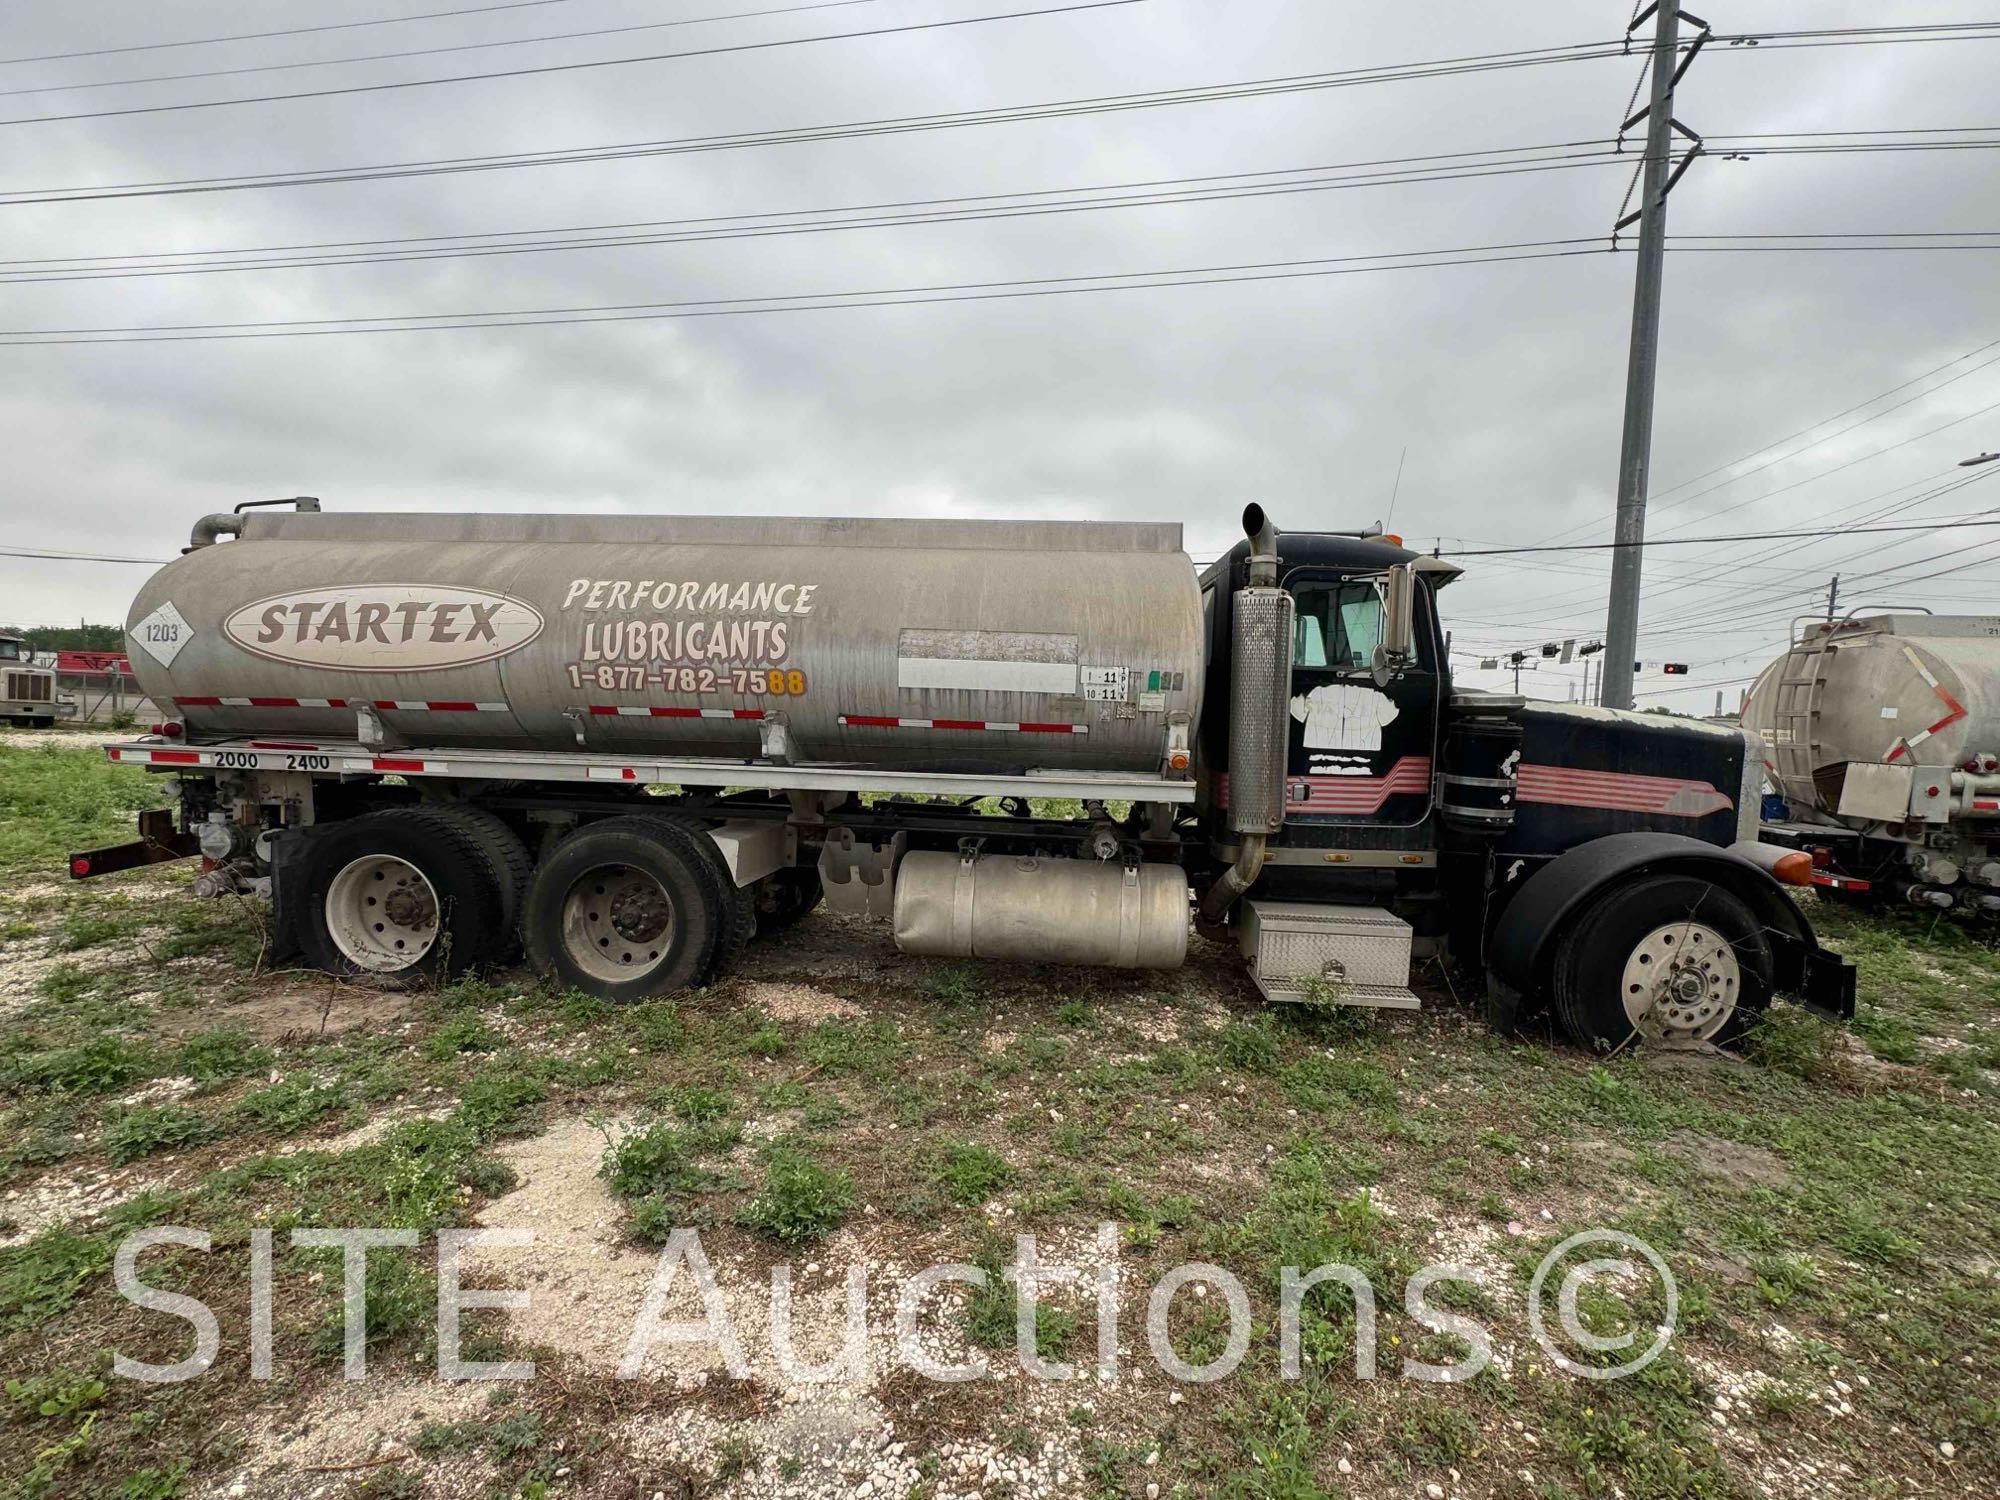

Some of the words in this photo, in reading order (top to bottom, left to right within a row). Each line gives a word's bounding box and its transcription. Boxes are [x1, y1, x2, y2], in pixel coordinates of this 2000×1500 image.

[562, 578, 818, 614] PERFORMANCE
[146, 624, 178, 642] 1203
[257, 602, 504, 644] STARTEX
[583, 620, 788, 661] LUBRICANTS
[567, 665, 806, 695] 1-877-782-7588
[215, 752, 259, 768] 2000
[286, 754, 330, 770] 2400
